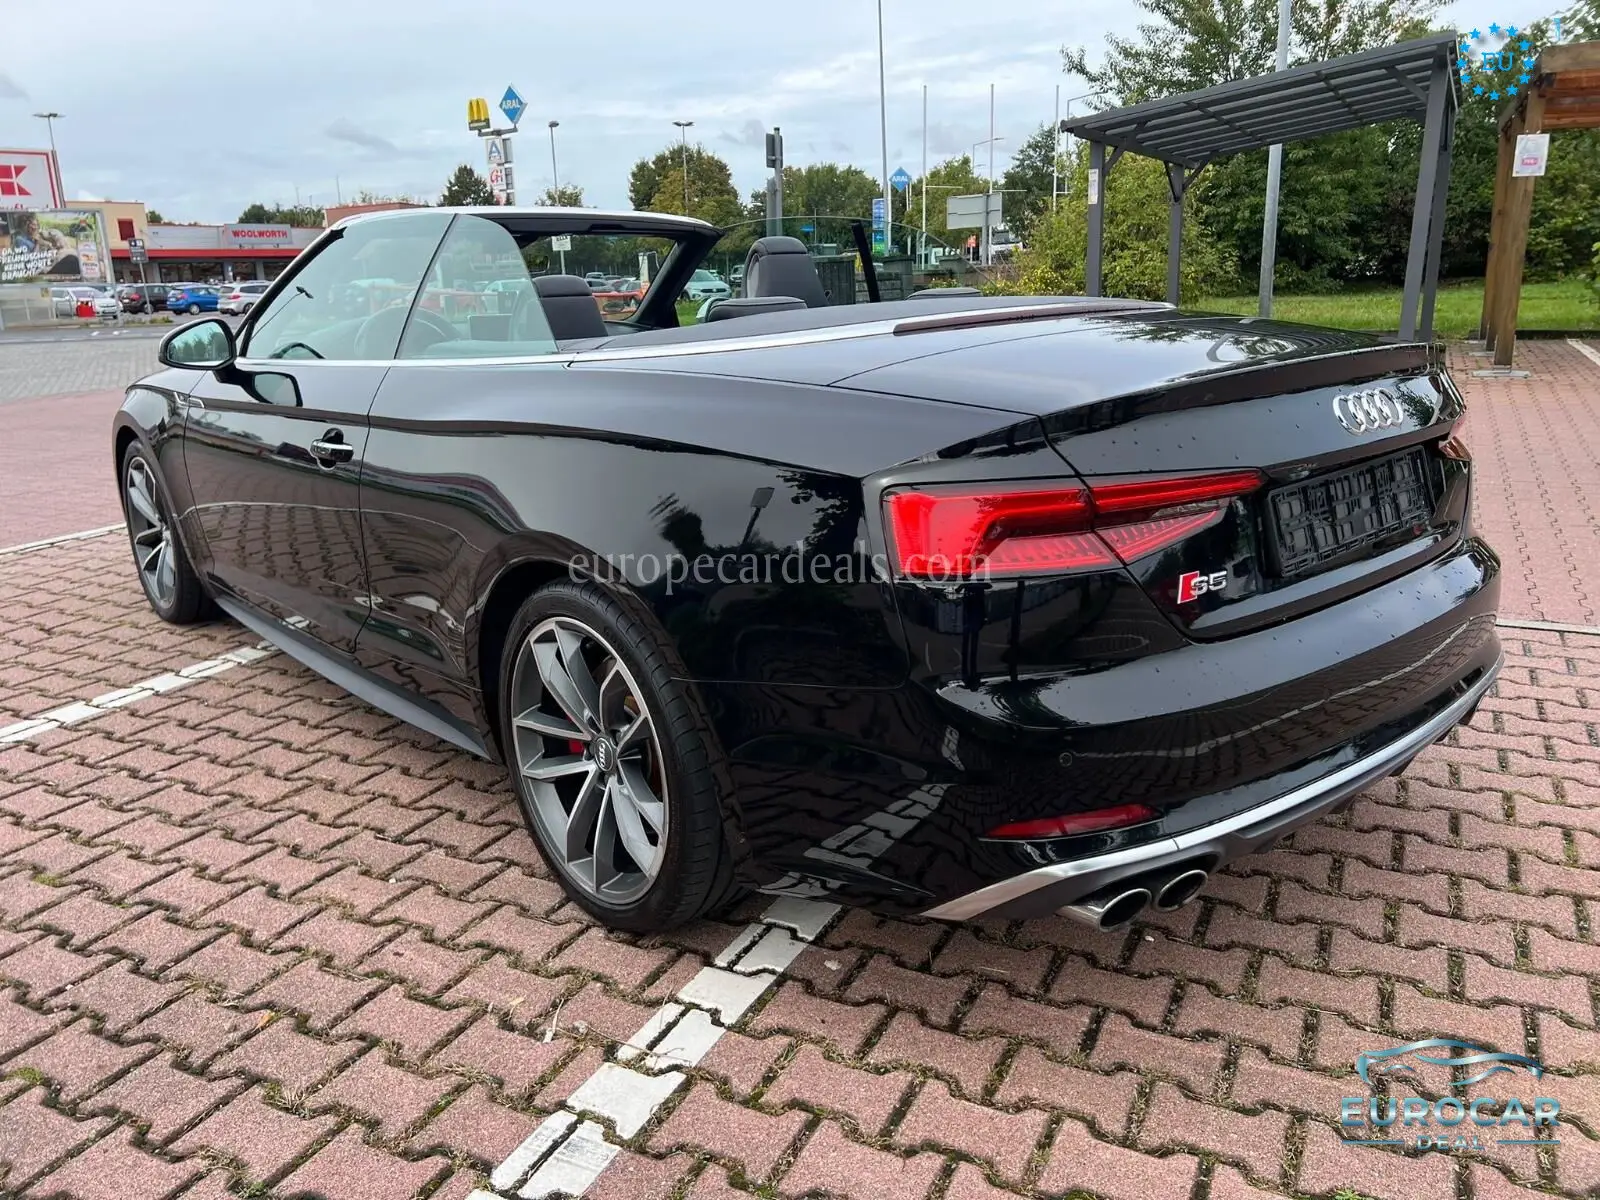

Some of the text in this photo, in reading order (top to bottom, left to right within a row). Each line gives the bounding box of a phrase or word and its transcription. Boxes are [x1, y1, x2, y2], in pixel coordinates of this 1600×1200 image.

[502, 99, 521, 110] ARAL
[232, 230, 288, 238] WOOLWORTH
[1190, 570, 1227, 595] S5
